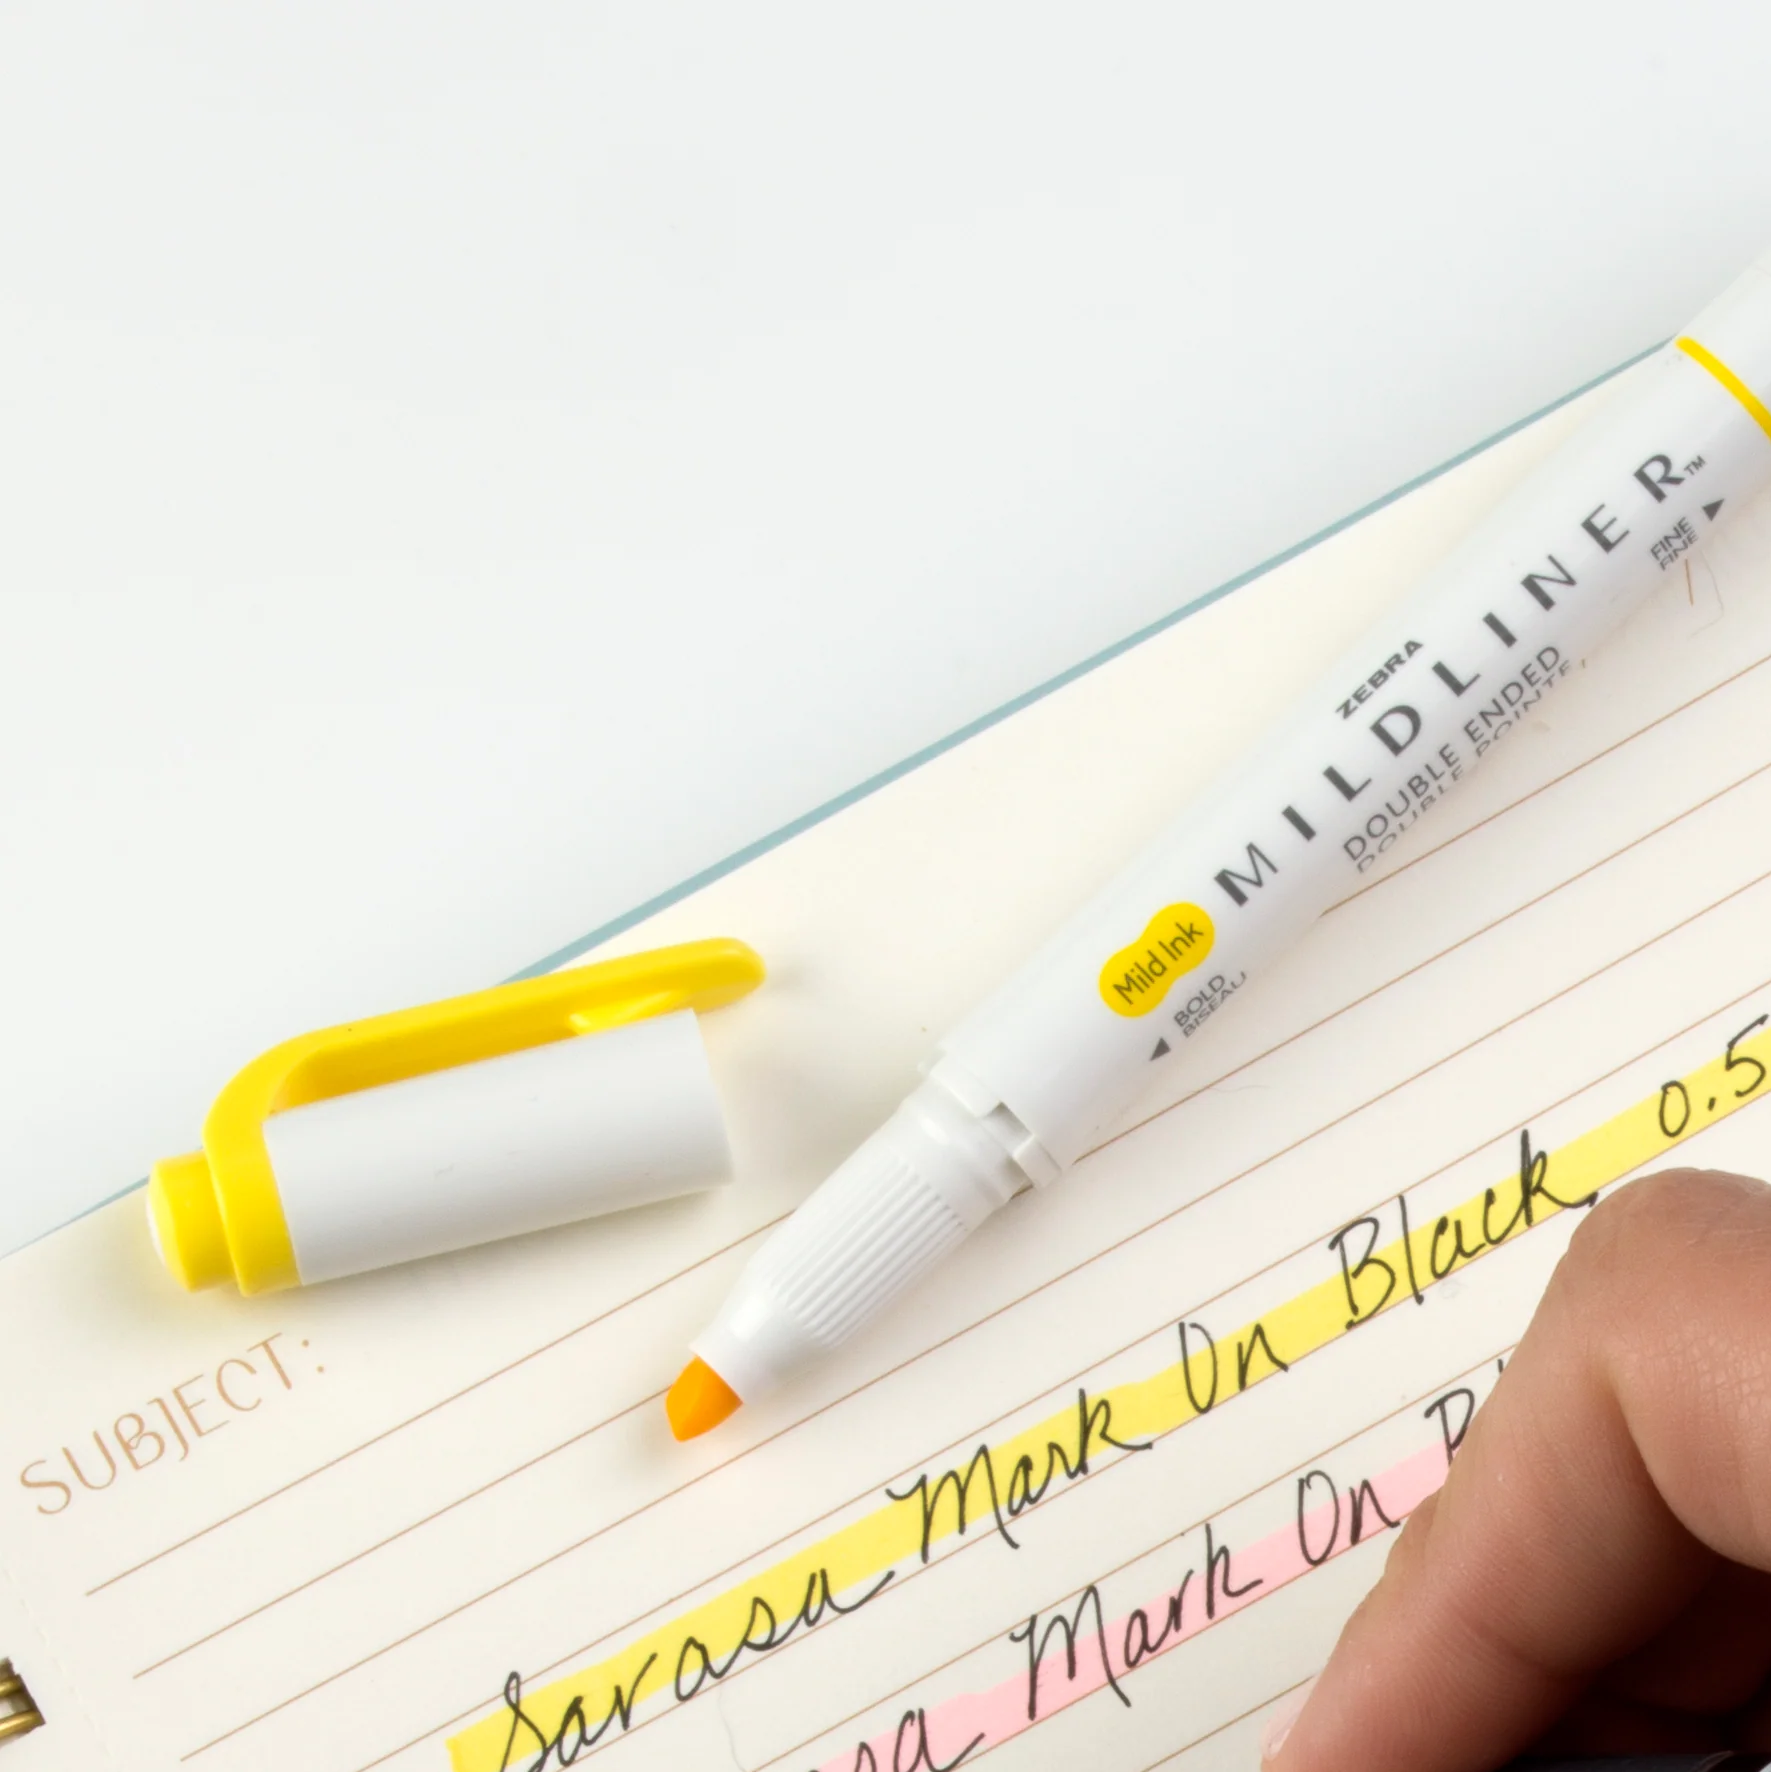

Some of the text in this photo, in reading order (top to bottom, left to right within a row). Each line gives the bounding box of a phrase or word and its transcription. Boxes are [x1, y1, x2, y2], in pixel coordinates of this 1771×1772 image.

[1650, 516, 1691, 561] FINE
[1659, 529, 1699, 571] FINE
[1336, 639, 1424, 720] ZEBRA
[1343, 646, 1561, 861] DOUBLE ENDED
[1112, 921, 1204, 1005] Mild Ink
[1173, 974, 1226, 1027] BOLD
[1182, 970, 1247, 1039] BISEAU
[20, 1332, 326, 1515] SUBJECT:
[886, 1388, 1153, 1563] Mark
[1179, 1321, 1290, 1414] On
[1009, 1522, 1264, 1721] Mark
[1296, 1469, 1401, 1567] On
